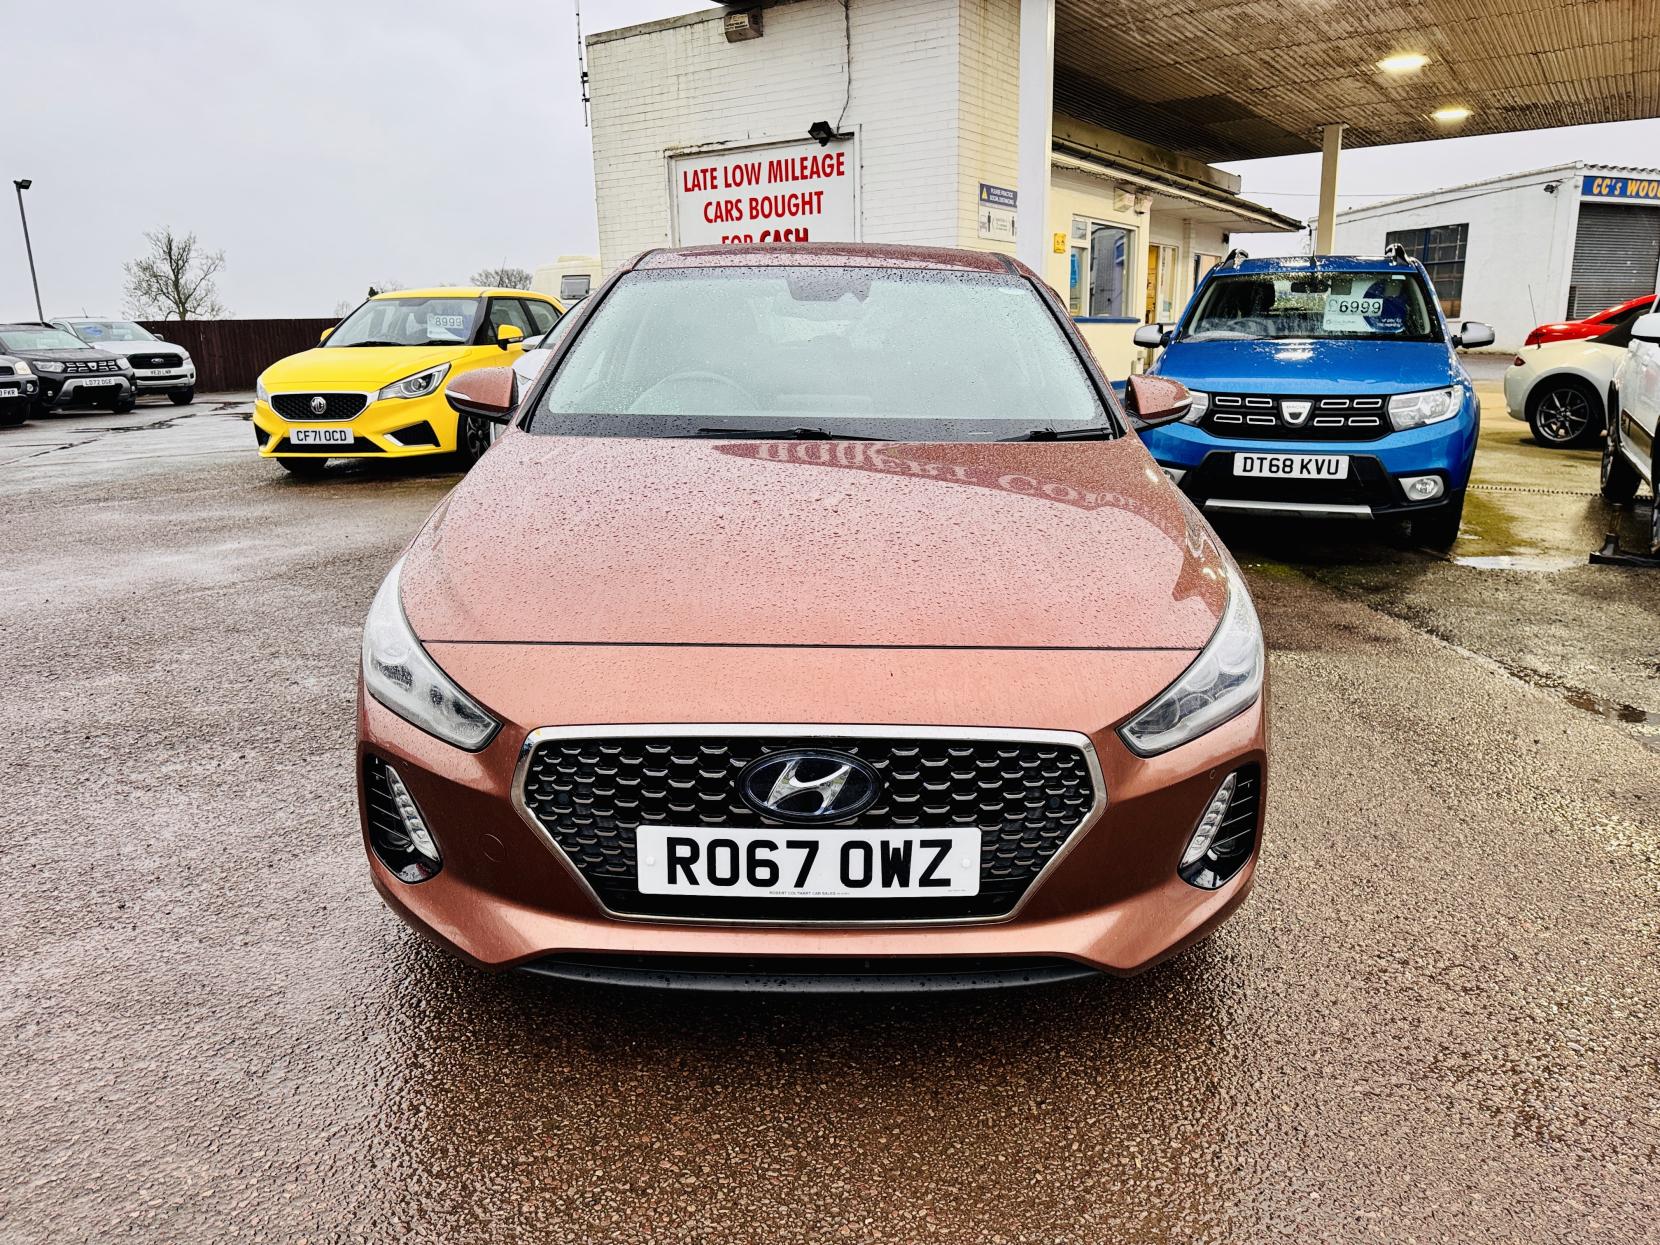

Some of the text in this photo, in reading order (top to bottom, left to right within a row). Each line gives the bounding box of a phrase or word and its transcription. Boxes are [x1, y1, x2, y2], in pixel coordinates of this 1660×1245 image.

[683, 152, 845, 193] LATE LOW MILEAGE
[1593, 178, 1660, 198] CC's WOO
[703, 190, 824, 224] CARS BOUGHT
[760, 227, 809, 243] CASH
[296, 430, 347, 442] CF71 OCD
[1242, 457, 1340, 476] DT68 KVU
[666, 836, 953, 889] RO67 OWZ
